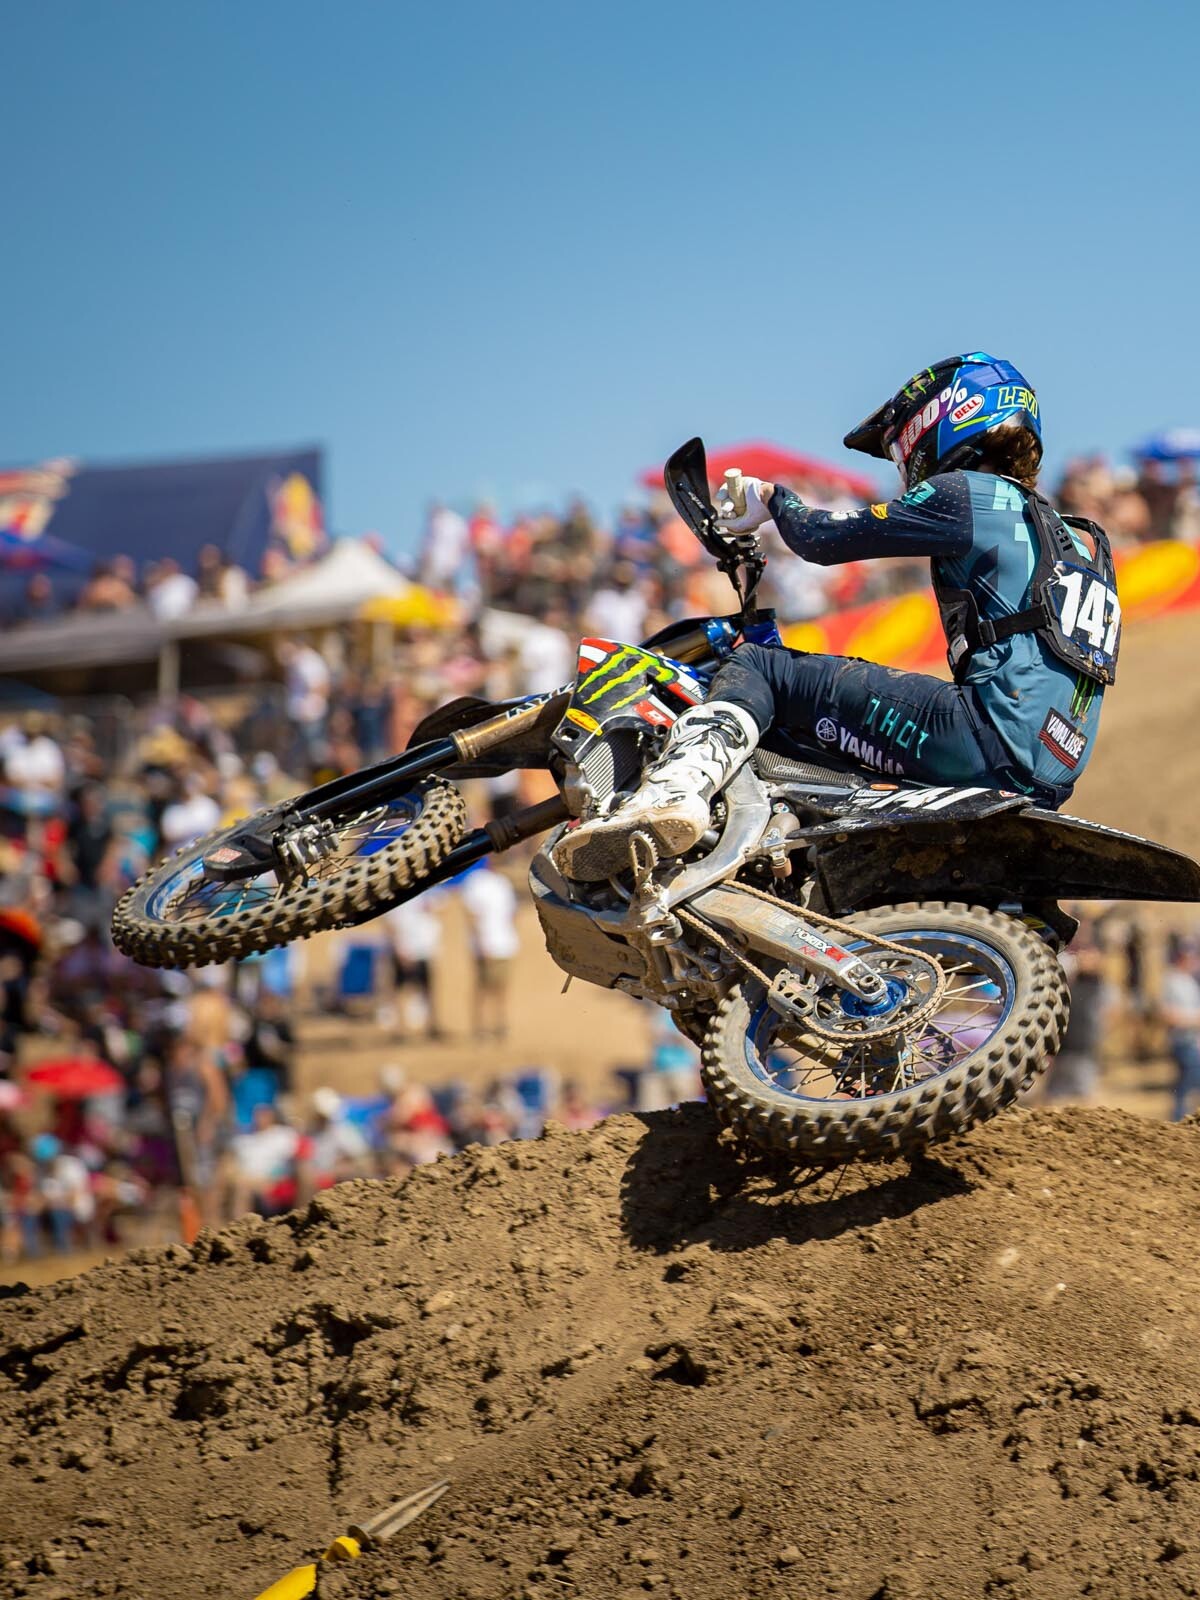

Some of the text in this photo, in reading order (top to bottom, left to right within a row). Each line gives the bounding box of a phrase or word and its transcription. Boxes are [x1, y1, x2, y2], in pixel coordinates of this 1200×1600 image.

[900, 377, 968, 458] 100%
[953, 399, 981, 421] BELL
[1057, 571, 1121, 657] 147
[792, 927, 833, 954] VORTEX
